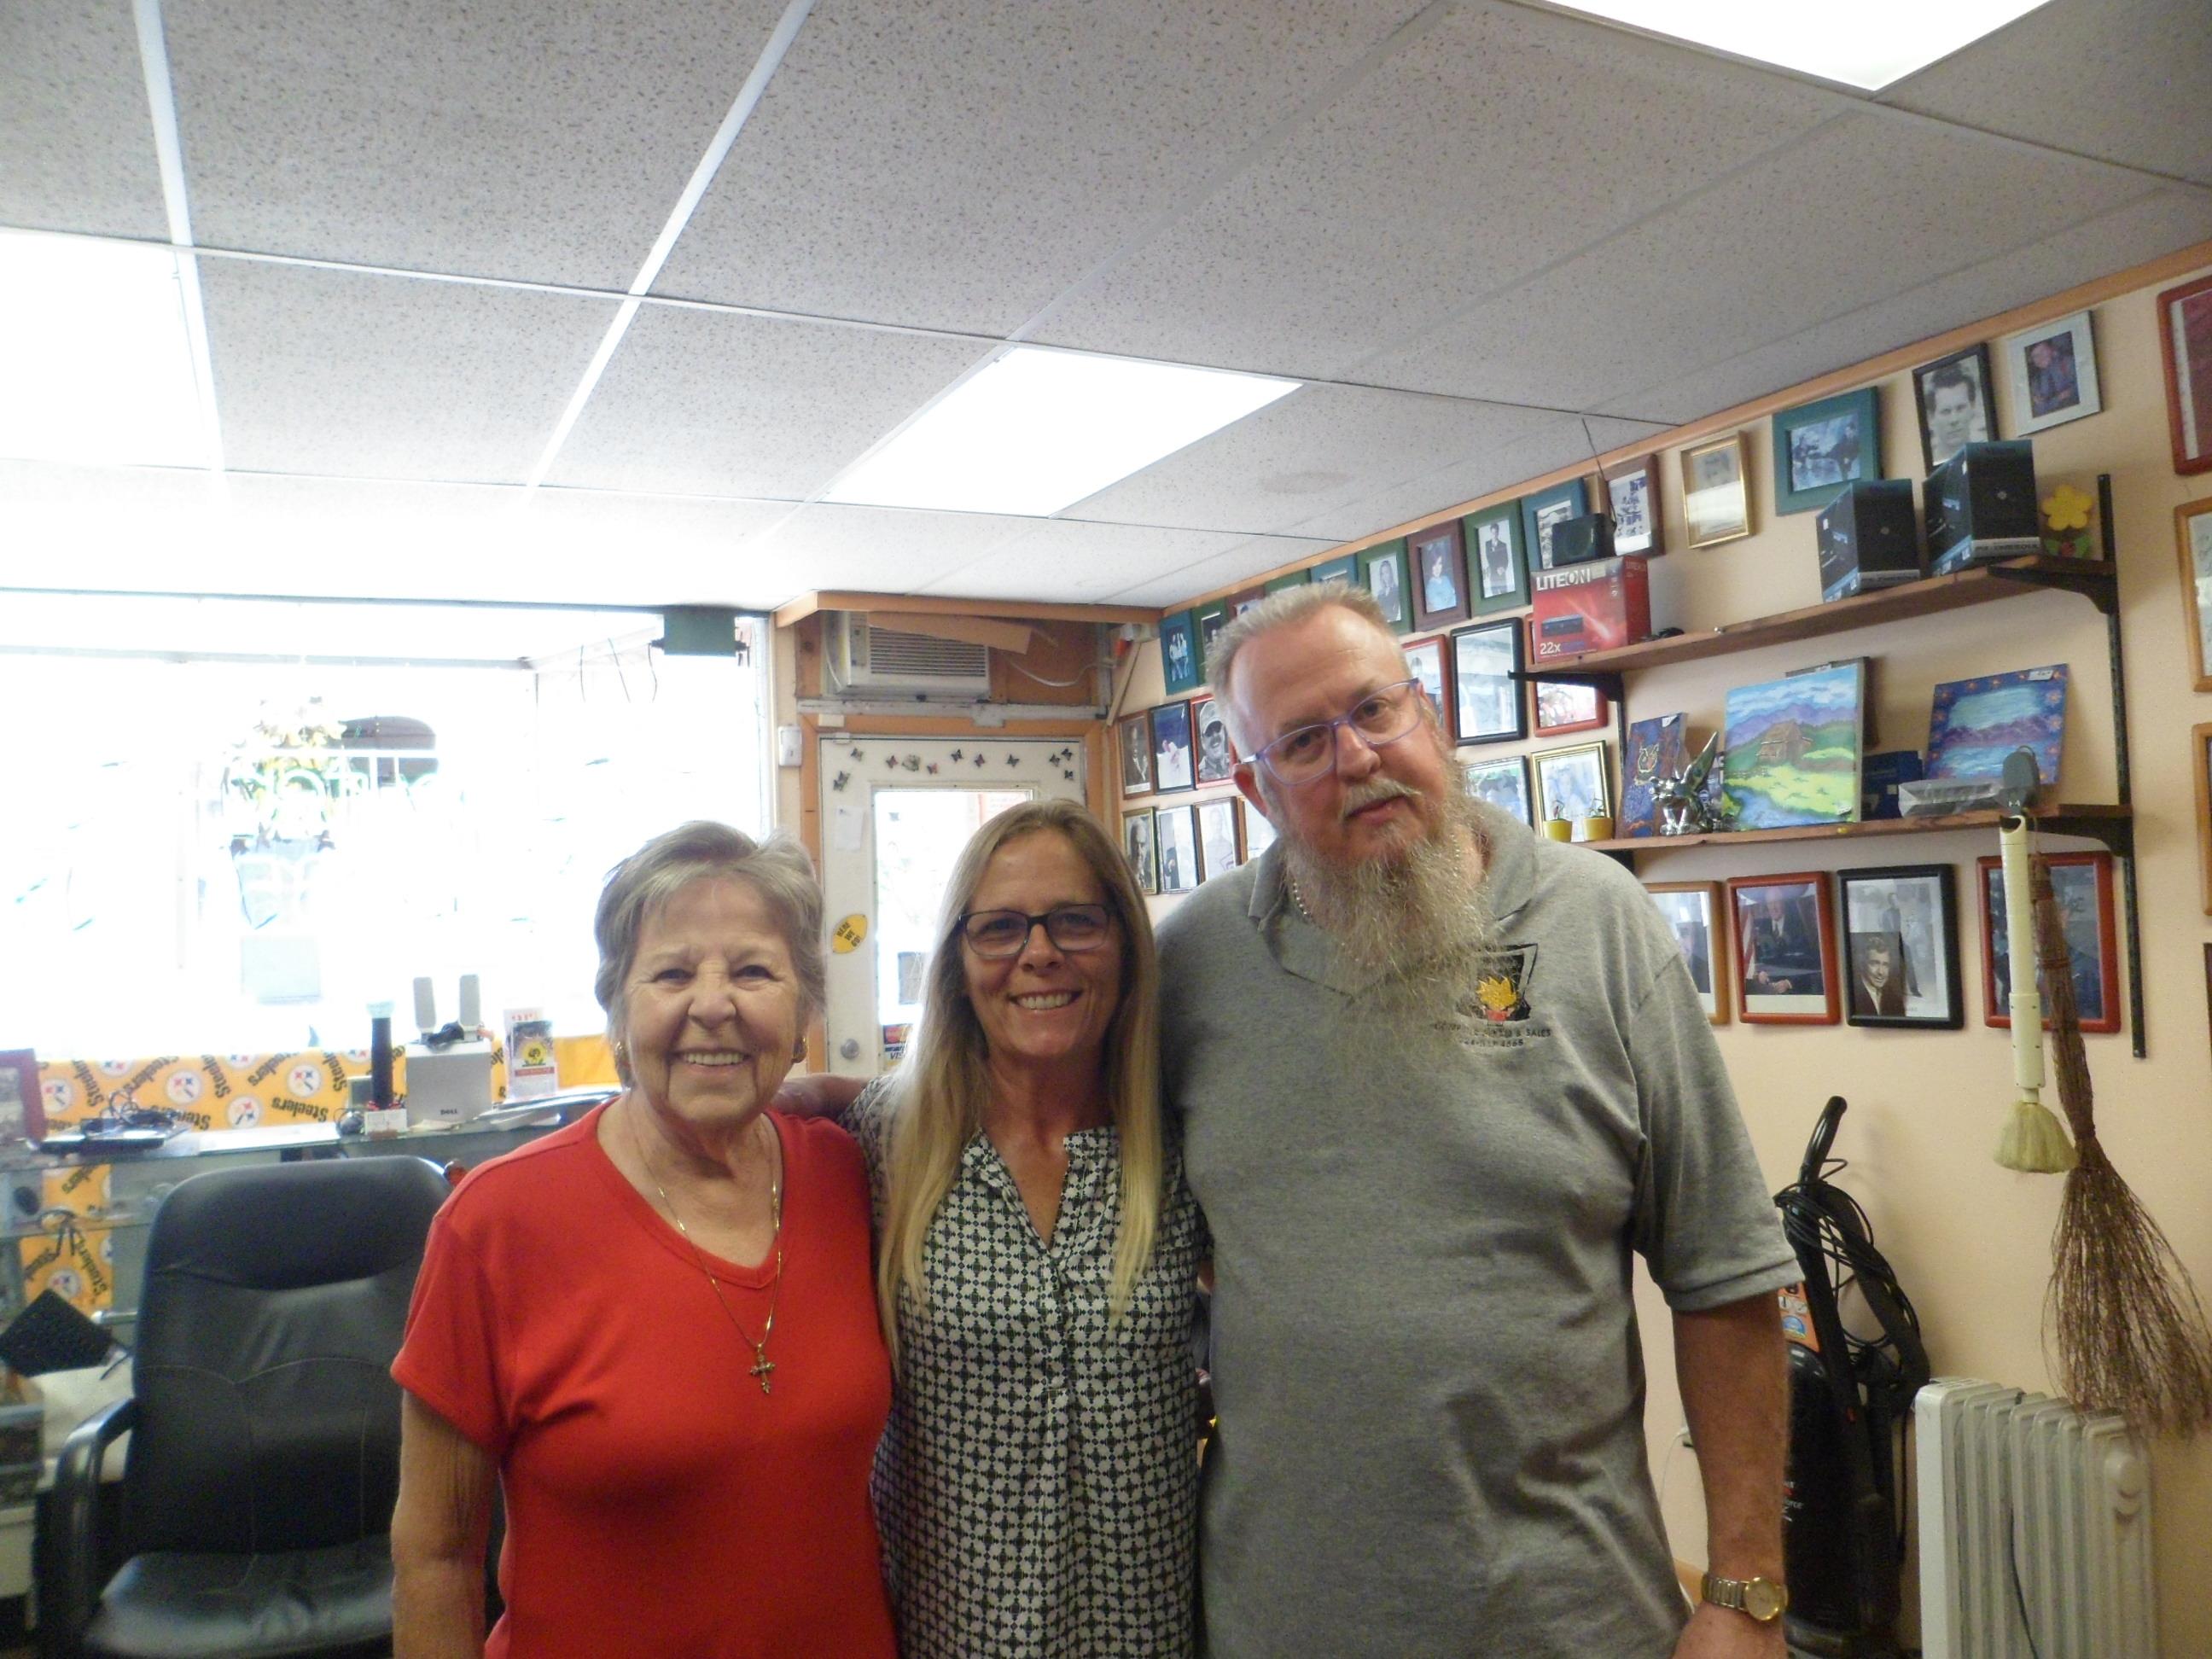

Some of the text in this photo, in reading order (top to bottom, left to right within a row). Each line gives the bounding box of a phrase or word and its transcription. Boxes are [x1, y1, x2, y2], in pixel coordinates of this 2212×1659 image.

[1536, 568, 1591, 591] LITEON
[1540, 641, 1561, 655] 22x
[271, 1097, 329, 1123] Steelers
